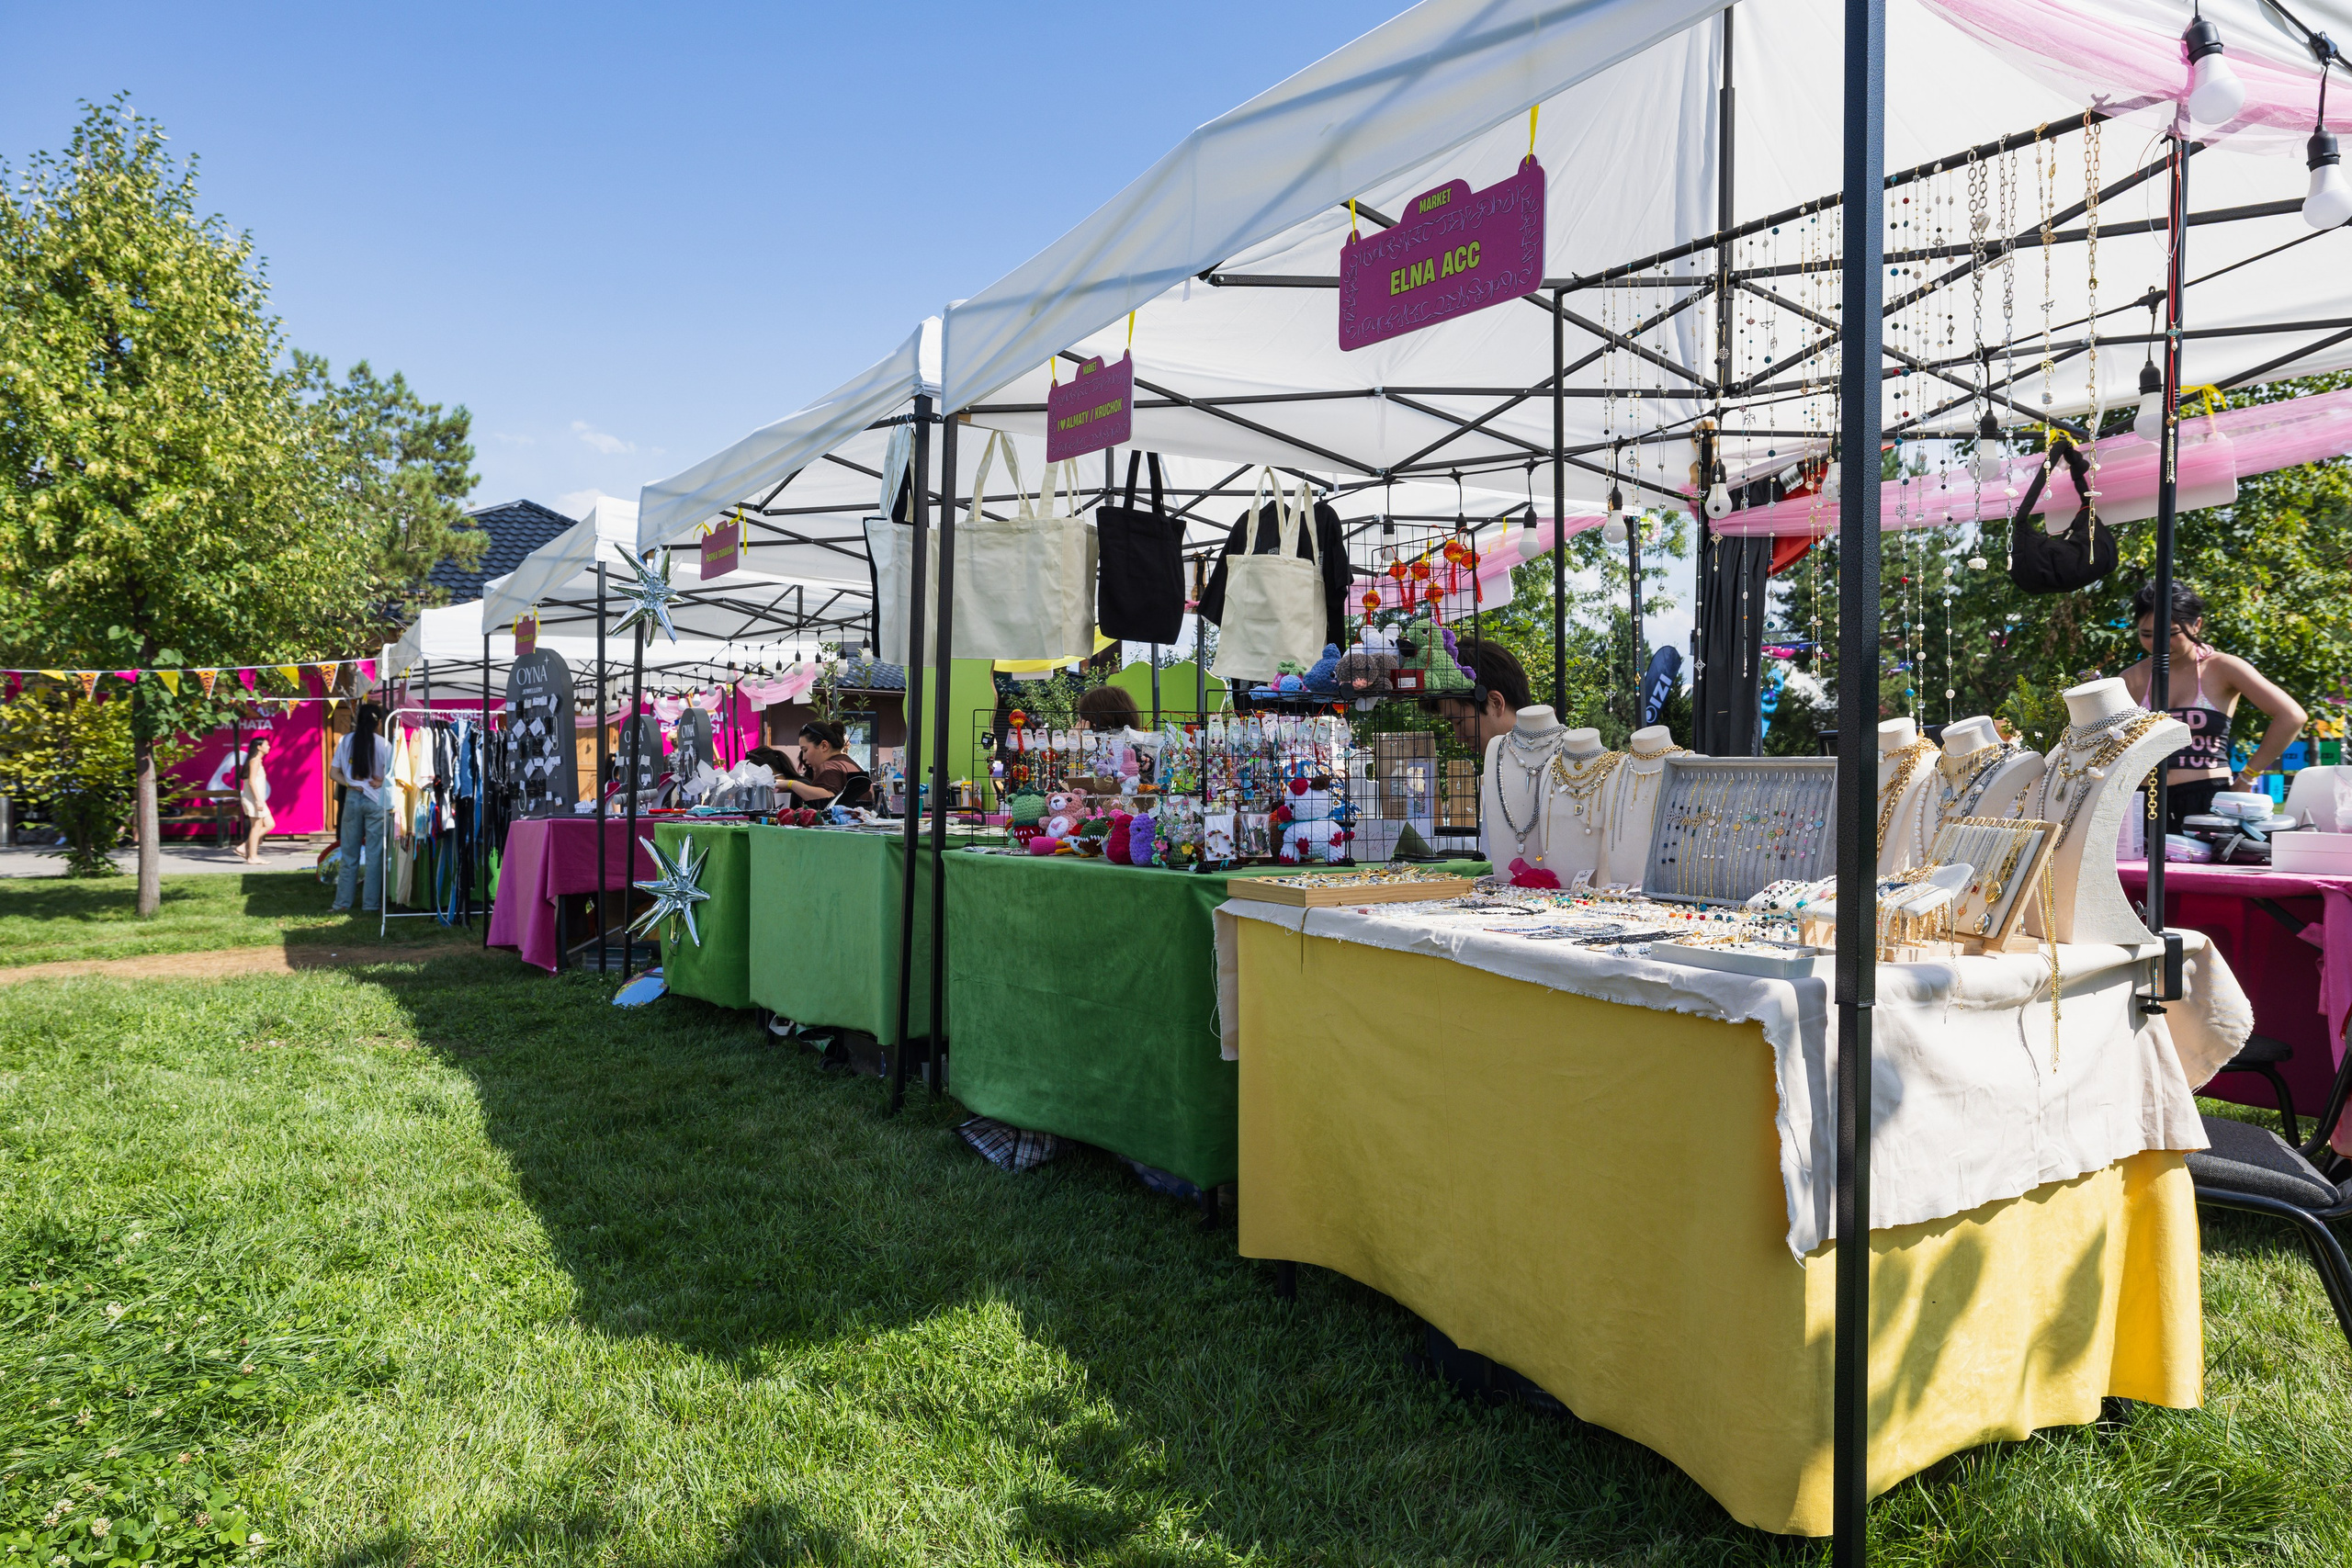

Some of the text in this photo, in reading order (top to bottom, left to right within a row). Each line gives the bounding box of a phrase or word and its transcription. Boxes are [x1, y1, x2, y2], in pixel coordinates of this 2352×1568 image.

[1419, 187, 1452, 215] MARKET
[1389, 241, 1481, 297] ELNA ACC
[1066, 410, 1090, 429] ALMATY
[516, 665, 548, 686] OYNA
[624, 729, 644, 743] OA
